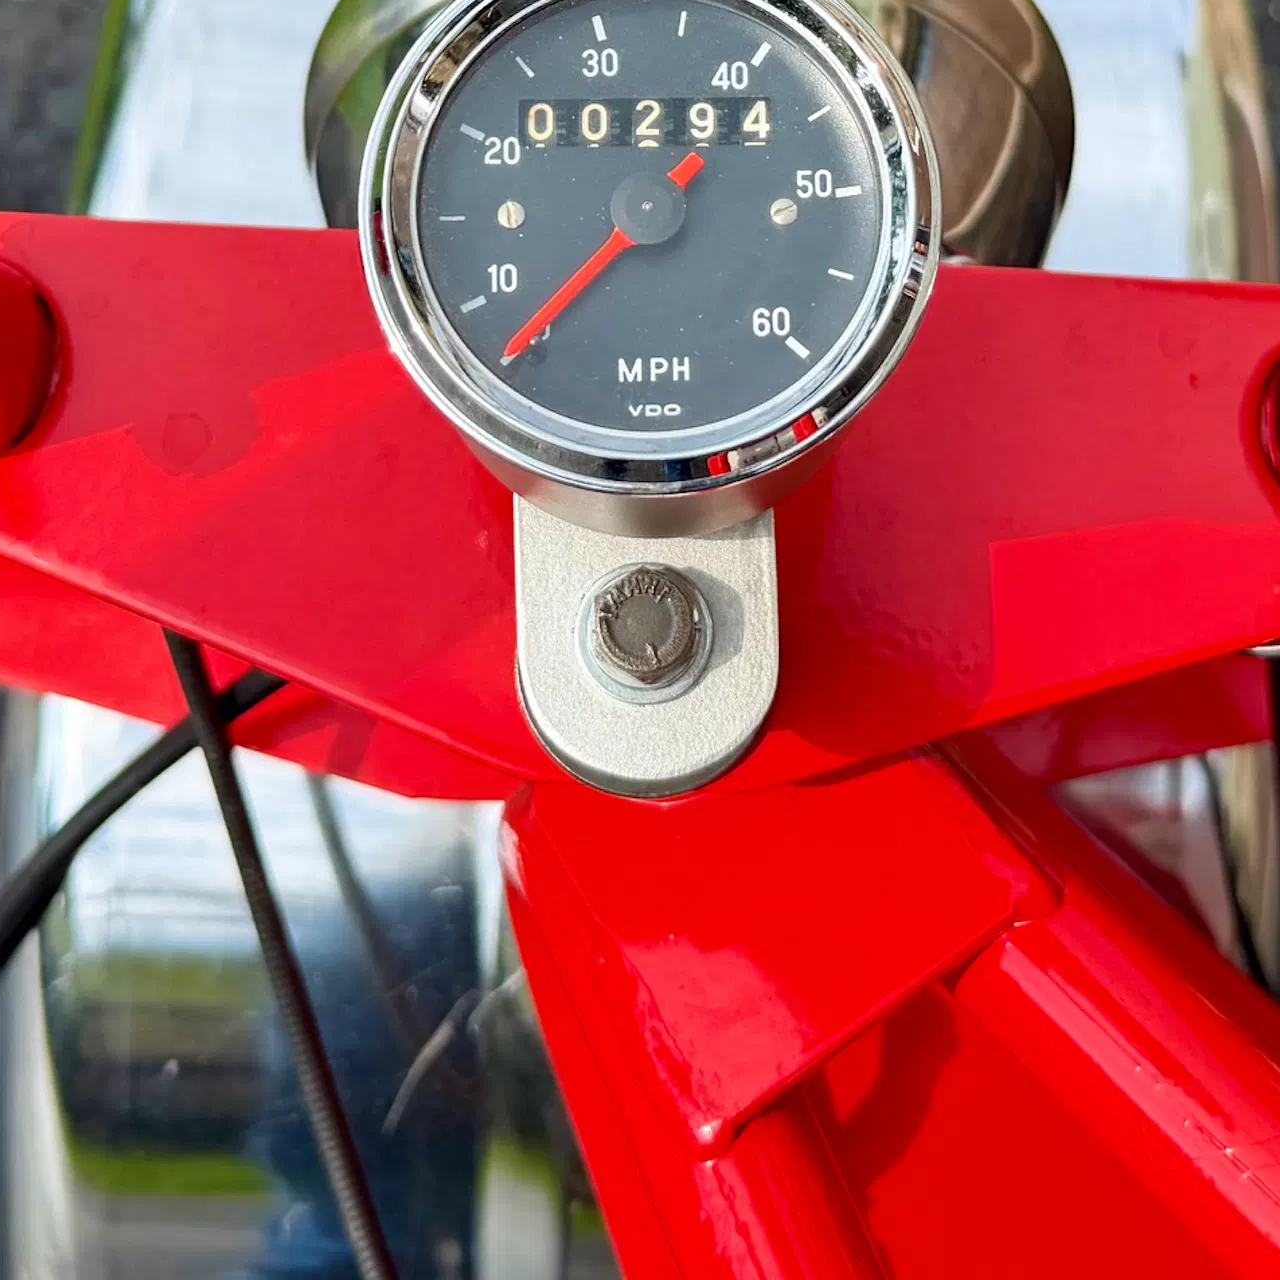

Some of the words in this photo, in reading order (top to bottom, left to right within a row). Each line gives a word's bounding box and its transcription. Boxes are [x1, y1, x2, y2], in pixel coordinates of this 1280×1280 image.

[581, 48, 619, 78] 30
[711, 61, 749, 90] 40
[527, 100, 771, 141] 00294
[484, 136, 520, 165] 20
[796, 169, 832, 199] 50
[487, 264, 518, 293] 10
[752, 306, 791, 337] 60
[618, 356, 691, 383] MPH
[628, 403, 682, 417] VDO
